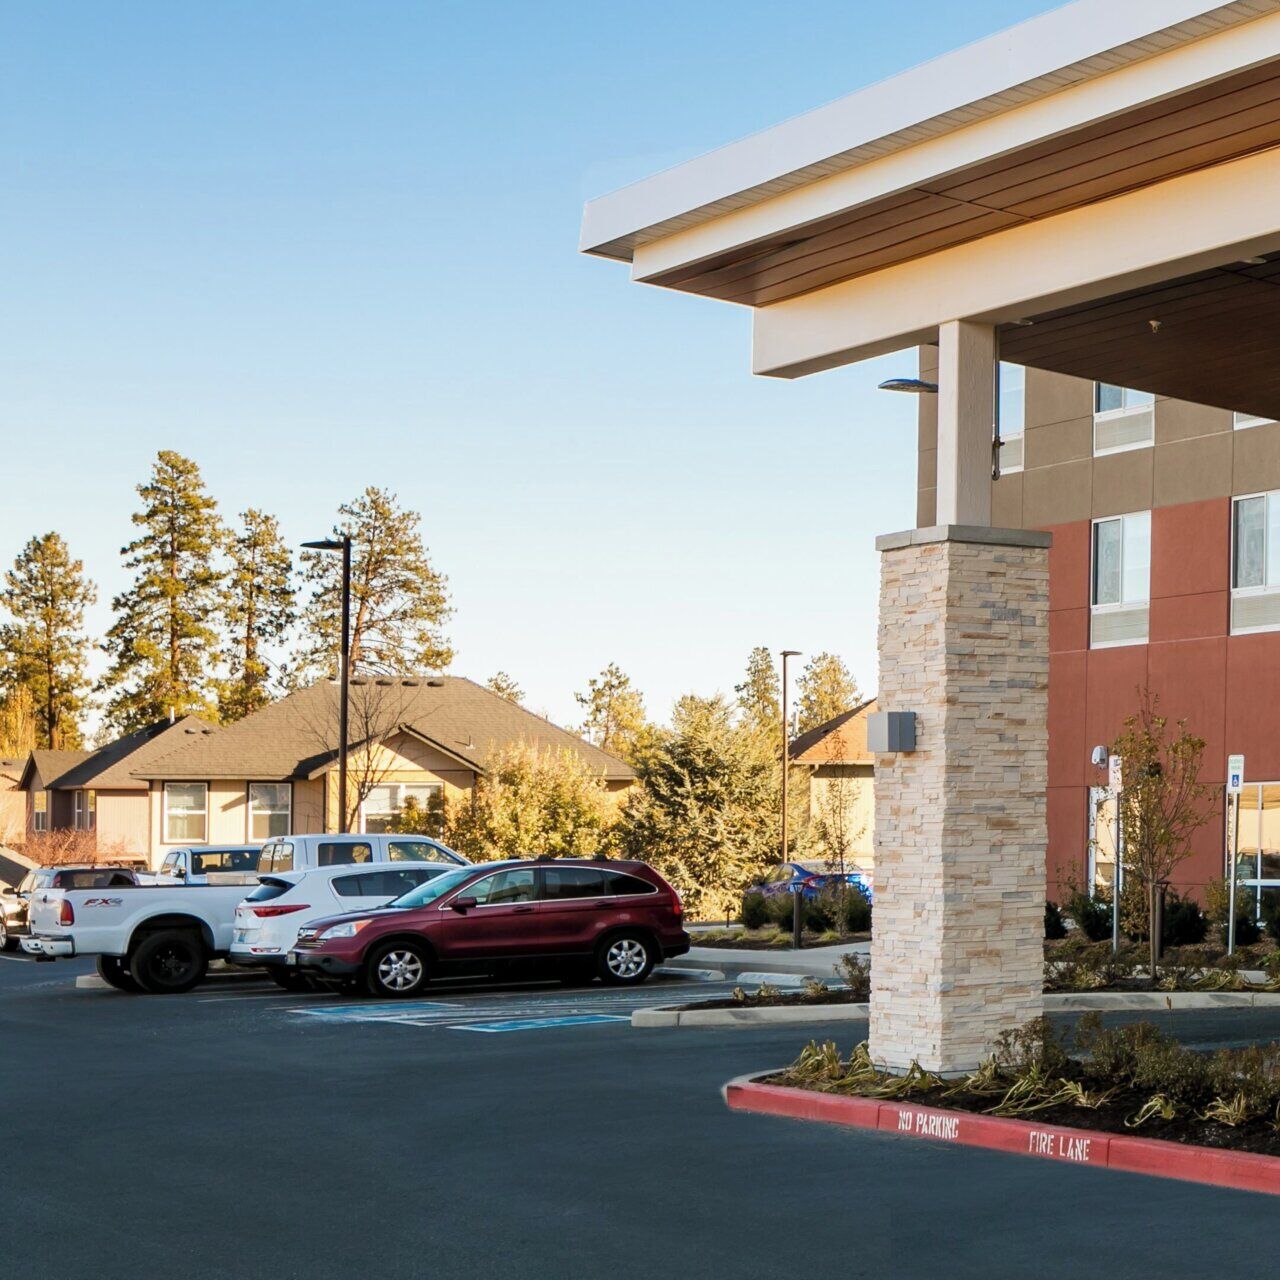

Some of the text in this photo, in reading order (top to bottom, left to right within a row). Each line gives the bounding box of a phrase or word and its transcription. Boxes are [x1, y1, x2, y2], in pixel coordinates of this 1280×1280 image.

[898, 1110, 959, 1139] NO PARKING
[1028, 1131, 1090, 1161] FIRE LANE
